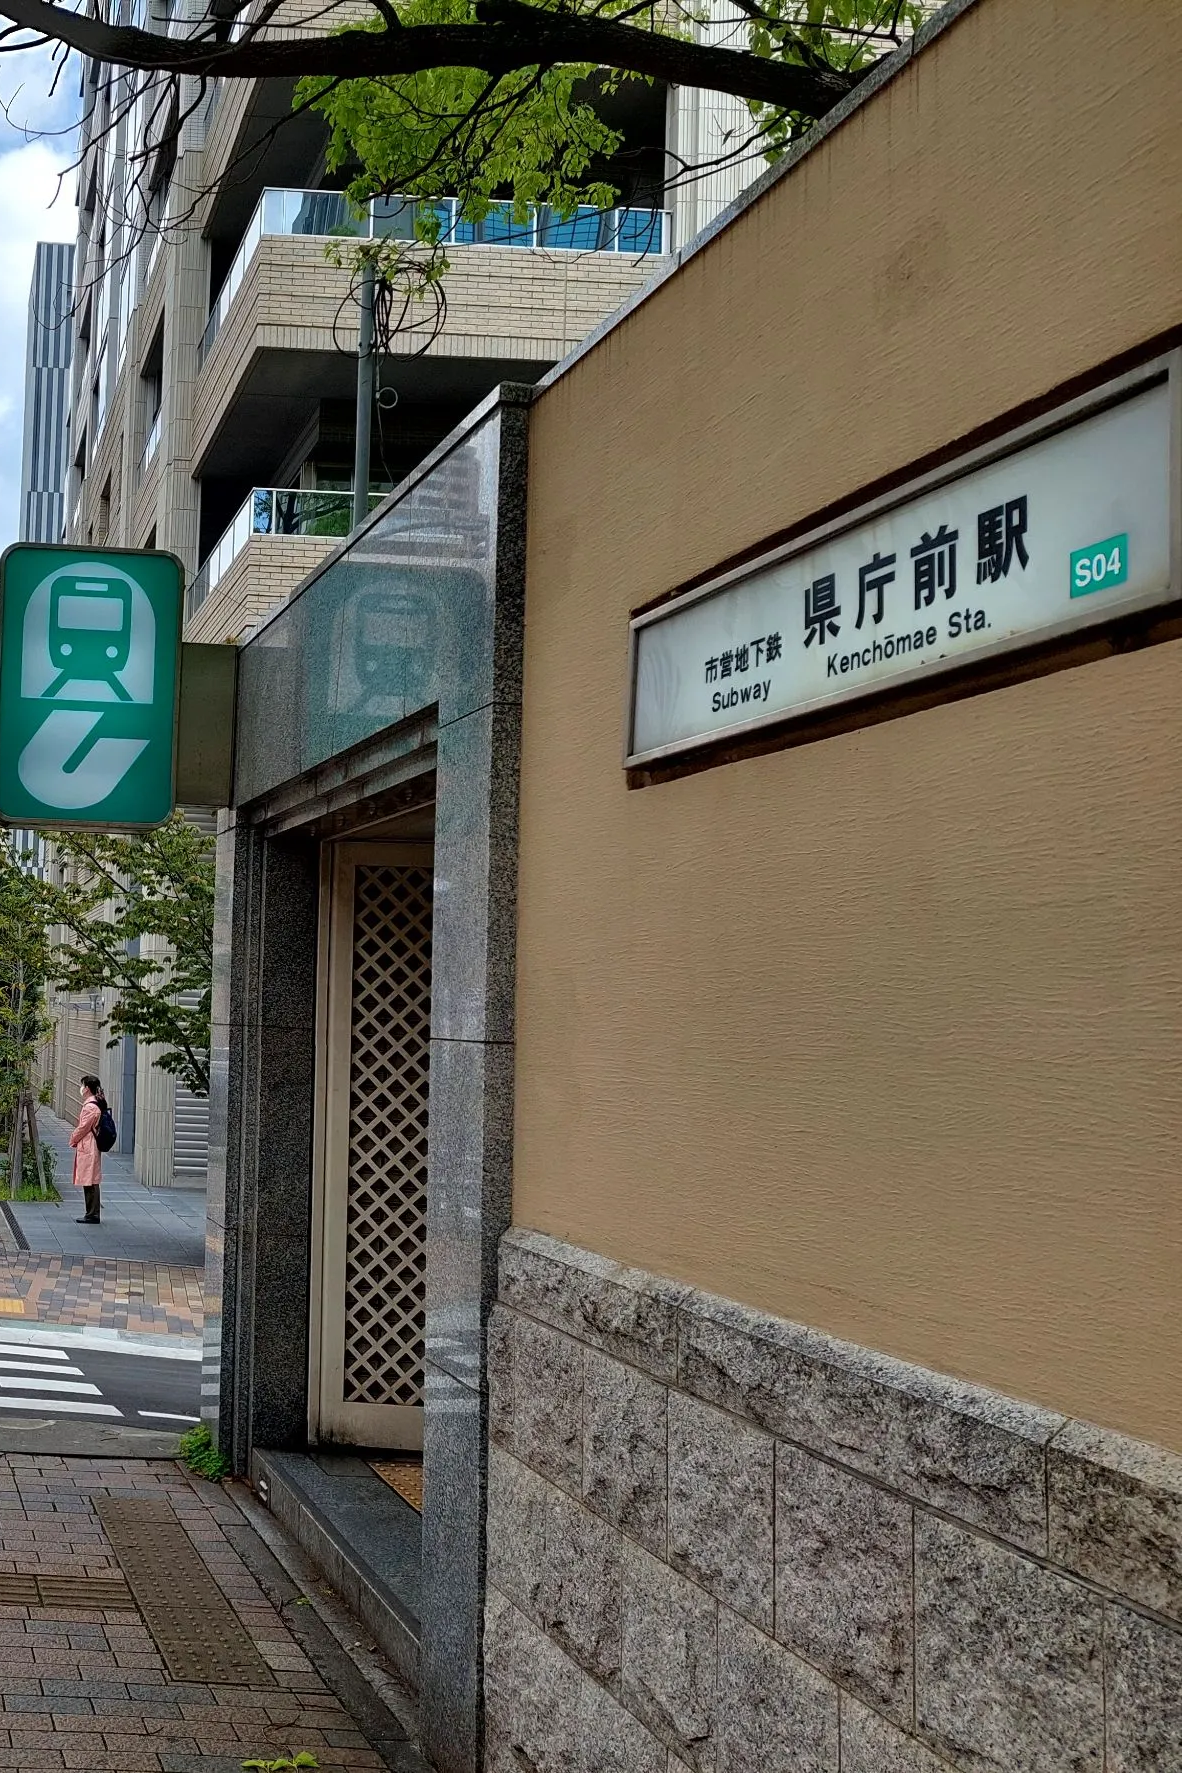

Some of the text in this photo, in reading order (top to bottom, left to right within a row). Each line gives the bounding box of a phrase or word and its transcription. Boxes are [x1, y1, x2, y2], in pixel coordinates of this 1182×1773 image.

[803, 494, 1030, 649] 県庁前駅
[1074, 547, 1122, 588] S04
[704, 631, 782, 684] 市営地下鉄
[826, 607, 992, 678] Kenchōmae Sta.
[711, 679, 771, 713] Subway
